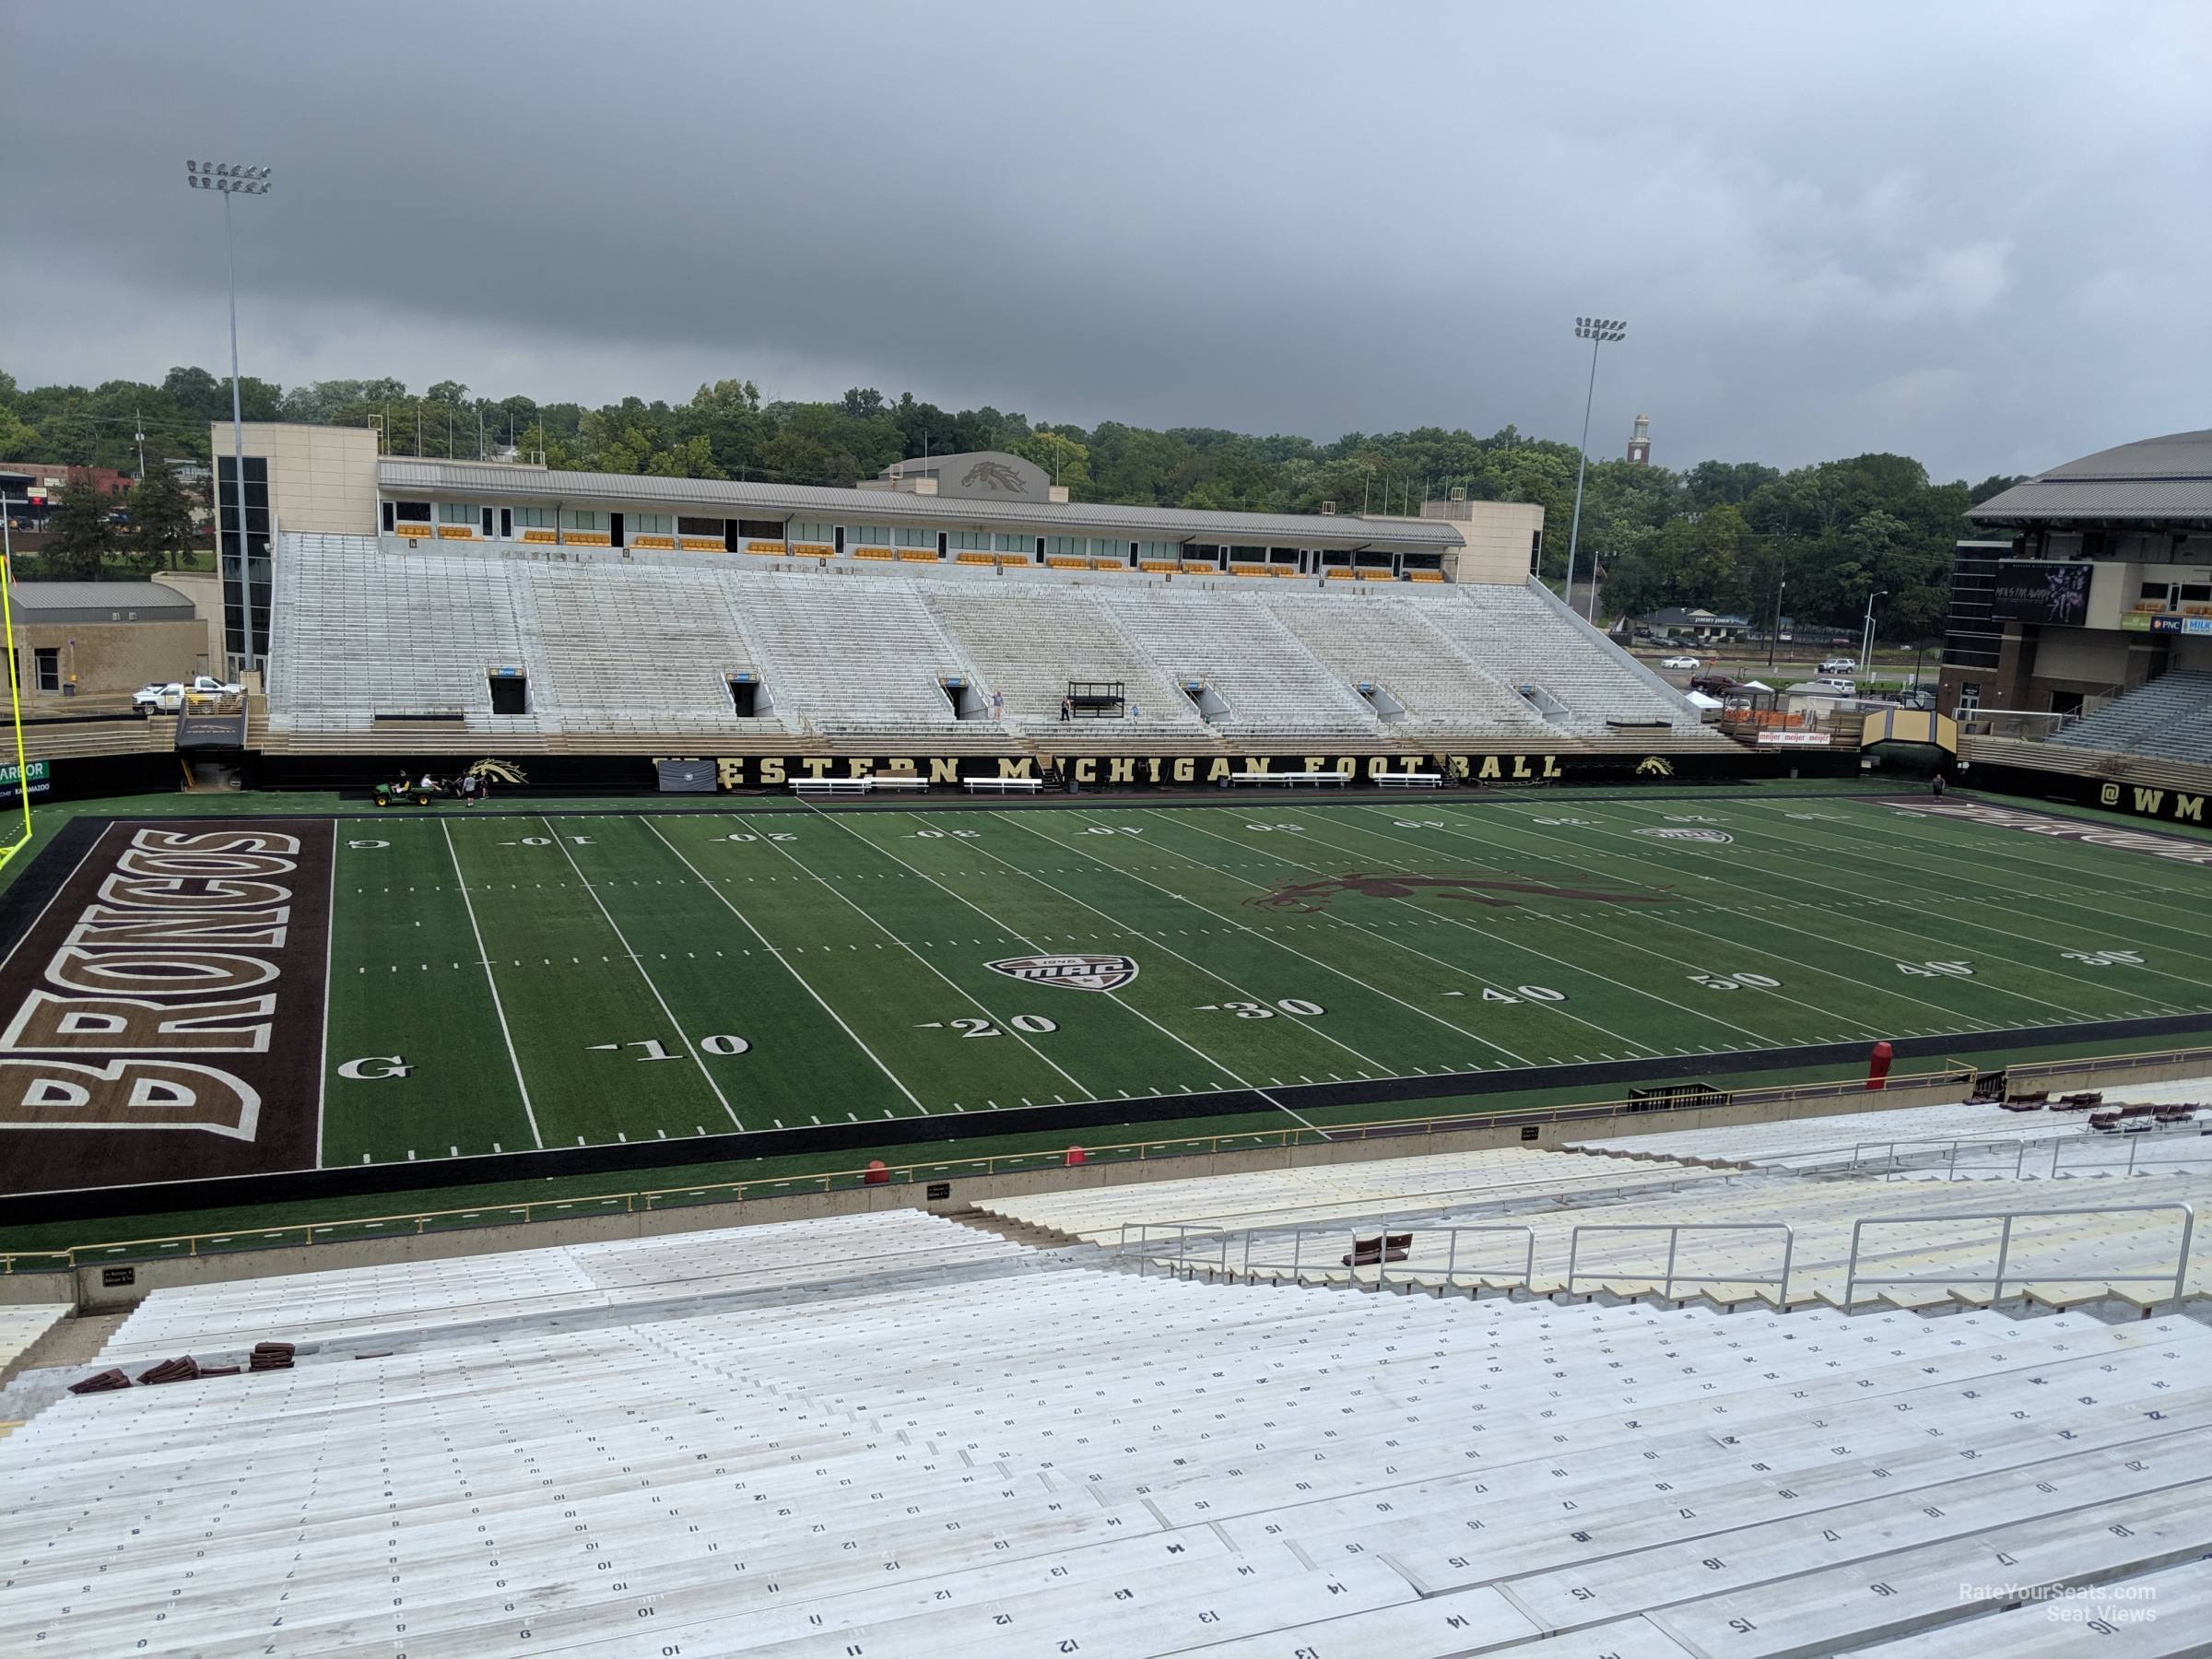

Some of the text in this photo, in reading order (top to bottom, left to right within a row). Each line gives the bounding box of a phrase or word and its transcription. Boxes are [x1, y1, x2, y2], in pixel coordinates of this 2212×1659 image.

[2161, 620, 2181, 629] PNC
[1759, 733, 1830, 743] meijer meijer meijer
[653, 757, 959, 782] ESTEN
[15, 783, 50, 794] KAAMAZOO
[2060, 951, 2146, 965] 30
[1013, 963, 1132, 979] MAC
[1896, 961, 1974, 977] 40
[0, 829, 301, 1143] BRONCOS
[1686, 972, 1782, 991] 50
[1482, 985, 1566, 1005] 40
[1223, 998, 1325, 1019] 30
[949, 1015, 1057, 1039] 20
[626, 1034, 750, 1063] 10
[337, 1055, 416, 1080] G
[1135, 1487, 1151, 1495] 15
[1295, 1482, 1312, 1490] 16
[1475, 1485, 1488, 1494] 17
[1654, 1483, 1674, 1491] 18
[2035, 1483, 2058, 1493] 19
[1002, 1490, 1016, 1499] 14
[1777, 1489, 1799, 1500] 18
[906, 1506, 921, 1514] 13
[1048, 1503, 1063, 1512] 14
[1194, 1501, 1210, 1510] 15
[1376, 1503, 1394, 1512] 16
[1562, 1501, 1579, 1511] 17
[1678, 1509, 1697, 1520] 17
[1923, 1507, 1946, 1518] 18
[945, 1523, 961, 1531] 13
[1106, 1518, 1123, 1527] 14
[1466, 1521, 1486, 1530] 16
[811, 1524, 826, 1533] 12
[1265, 1524, 1283, 1535] 15
[2108, 1524, 2136, 1538] 18
[1570, 1531, 1594, 1543] 18
[1822, 1530, 1841, 1542] 17
[585, 1543, 601, 1553] 10
[707, 1544, 718, 1552] 11
[841, 1541, 857, 1550] 12
[994, 1541, 1010, 1550] 13
[1165, 1544, 1186, 1555] 14
[1345, 1544, 1365, 1554] 15
[1448, 1557, 1471, 1569] 15
[1701, 1558, 1727, 1571] 16
[1995, 1553, 2018, 1567] 17
[597, 1561, 612, 1571] 10
[734, 1563, 746, 1571] 11
[883, 1561, 900, 1571] 12
[1237, 1566, 1256, 1576] 14
[1050, 1567, 1069, 1577] 13
[81, 1585, 91, 1594] 5
[496, 1580, 508, 1588] 9
[612, 1583, 629, 1592] 10
[766, 1583, 780, 1594] 11
[1326, 1583, 1348, 1595] 14
[934, 1590, 952, 1601] 12
[1113, 1589, 1135, 1601] 13
[1571, 1587, 1596, 1601] 15
[1869, 1583, 1899, 1597] 16
[279, 1593, 289, 1601] 7
[393, 1598, 403, 1606] 8
[504, 1604, 515, 1612] 9
[637, 1607, 655, 1618] 10
[272, 1618, 283, 1627] 7
[808, 1615, 823, 1626] 11
[992, 1614, 1014, 1626] 12
[1197, 1611, 1221, 1624] 13
[1445, 1615, 1471, 1630] 14
[395, 1624, 406, 1632] 8
[1728, 1618, 1758, 1634] 15
[2086, 1618, 2120, 1636] 16
[35, 1632, 47, 1641] 5
[519, 1630, 532, 1640] 9
[136, 1639, 148, 1649] 6
[1055, 1639, 1080, 1653] 12
[264, 1645, 276, 1655] 7
[662, 1645, 681, 1657] 10
[845, 1645, 864, 1657] 11
[1294, 1647, 1321, 1659] 13
